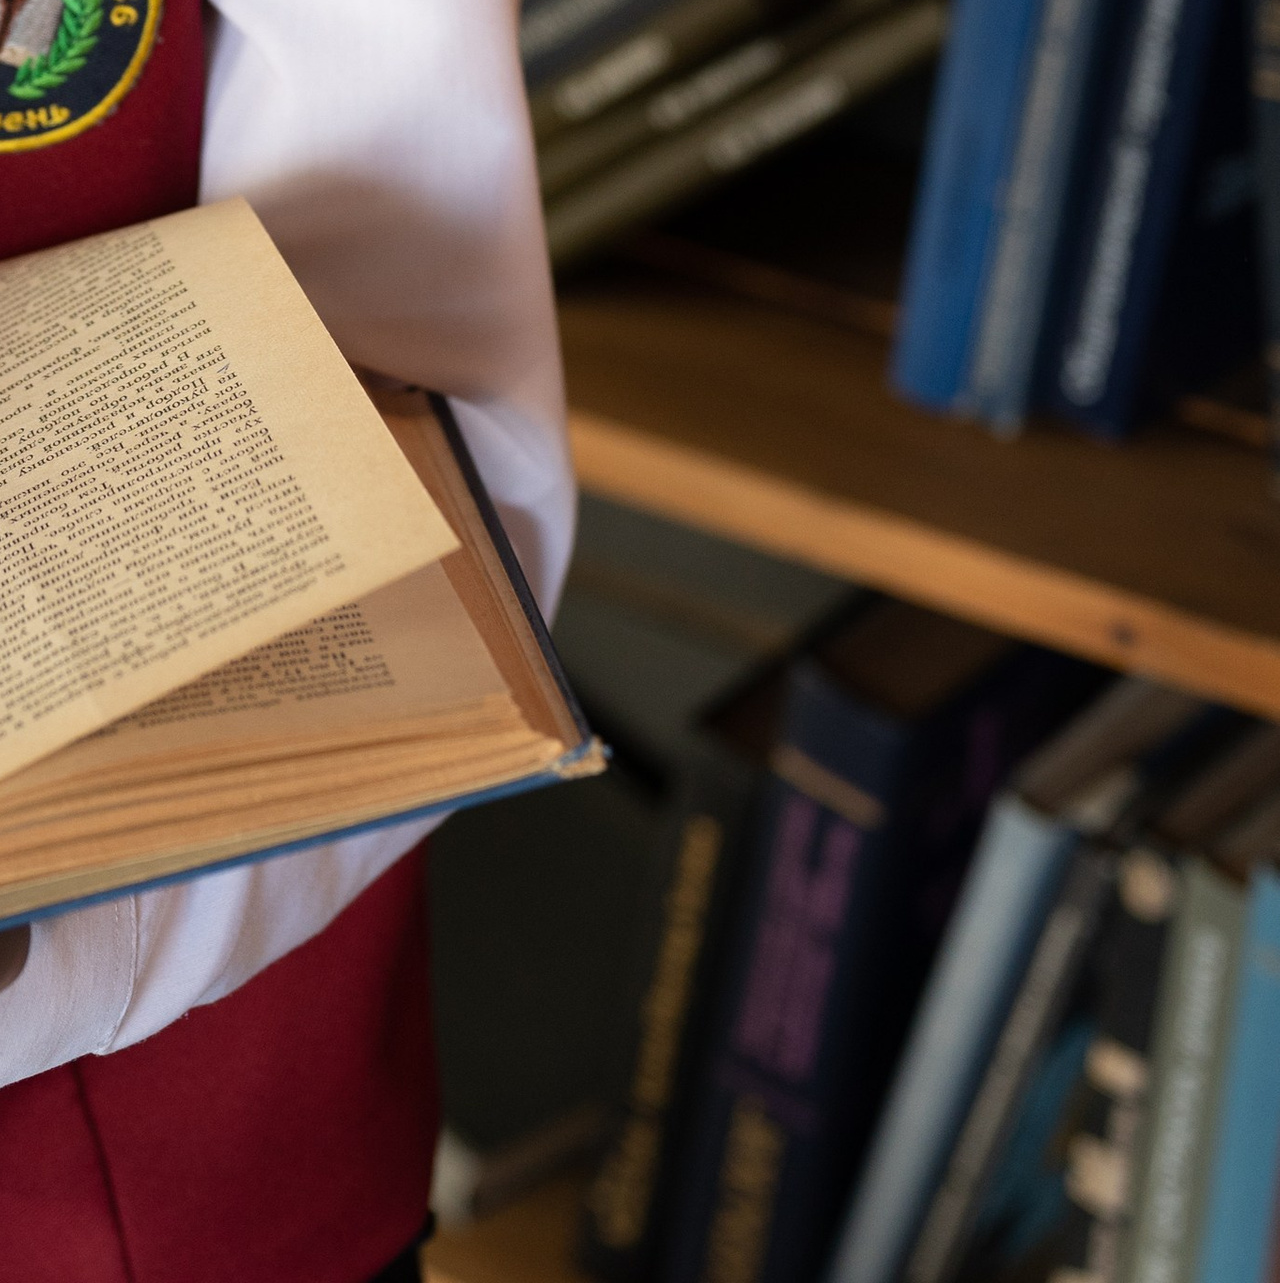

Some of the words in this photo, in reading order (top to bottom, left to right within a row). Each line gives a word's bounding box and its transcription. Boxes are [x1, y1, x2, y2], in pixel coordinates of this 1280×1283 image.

[131, 318, 206, 361] основных
[159, 327, 212, 358] ваться
[176, 351, 189, 362] В
[194, 345, 222, 362] эти
[116, 360, 168, 393] работе
[134, 362, 188, 394] звенья
[168, 352, 226, 387] ривать
[217, 371, 237, 385] на
[45, 388, 56, 398] и
[88, 394, 108, 407] по
[144, 377, 204, 410] Подбор
[154, 386, 164, 394] в
[213, 381, 242, 398] ток
[15, 408, 80, 445] подбору
[52, 394, 128, 436] образуют
[124, 411, 135, 420] и
[177, 419, 186, 428] а
[190, 398, 253, 431] бочных
[192, 406, 258, 442] участка
[234, 417, 263, 435] ху»
[94, 441, 124, 459] Все
[124, 428, 169, 455] через
[218, 434, 273, 466] работе
[232, 426, 270, 447] база
[59, 460, 86, 477] это
[200, 466, 210, 474] с
[6, 476, 96, 525] связанных
[77, 481, 109, 500] Тем
[122, 475, 192, 513] кадрами
[22, 501, 68, 528] более
[66, 514, 114, 541] такая
[1, 542, 57, 574] четкая
